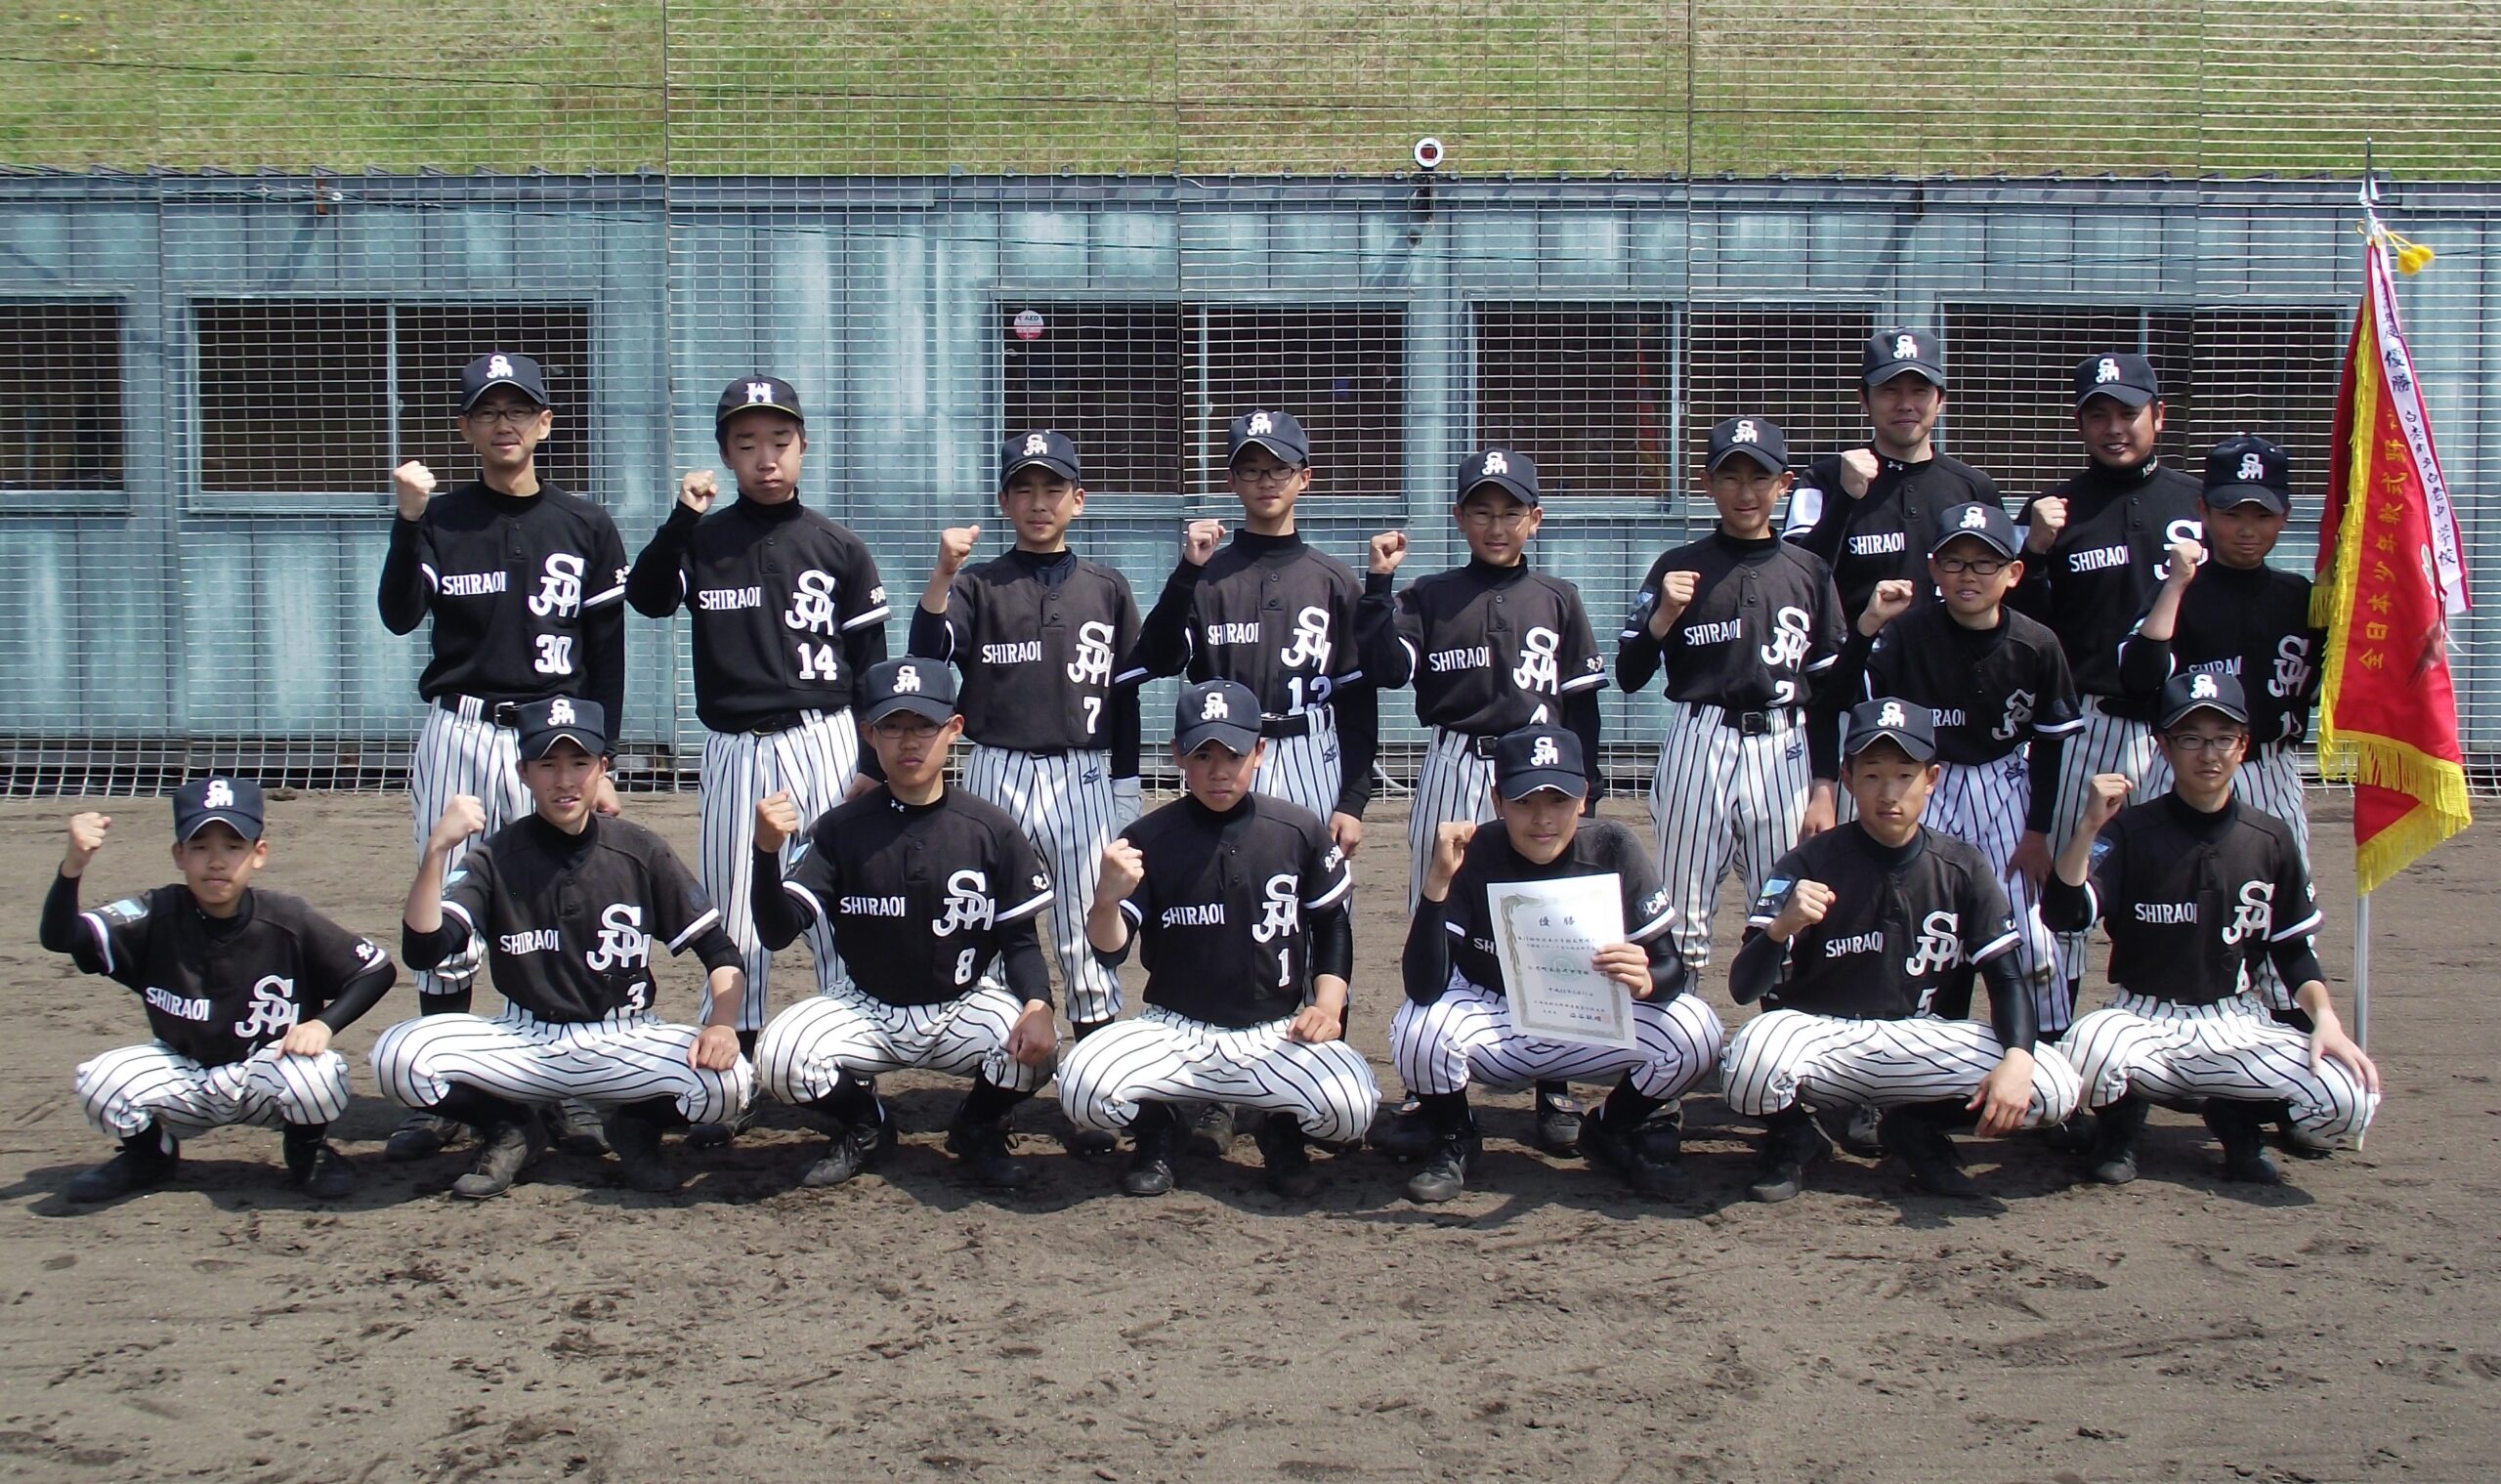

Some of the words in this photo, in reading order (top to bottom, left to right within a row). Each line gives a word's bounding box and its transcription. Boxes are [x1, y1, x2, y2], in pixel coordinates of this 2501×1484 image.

[1848, 531, 1905, 555] SHIRAOI
[2068, 545, 2130, 572] SHIRAOI
[441, 571, 507, 596] SHIRAOI
[698, 586, 762, 611] SHIRAOI
[1208, 621, 1260, 646] SHIRAOI
[1683, 617, 1742, 646] SHIRAOI
[534, 633, 572, 675] 30
[797, 642, 838, 681] 14
[982, 640, 1042, 664] SHIRAOI
[1428, 646, 1491, 672] SHIRAOI
[1082, 696, 1102, 735] 7
[1930, 707, 1966, 728] RAOI
[839, 896, 906, 917] SHIRAOI
[1162, 903, 1225, 928] SHIRAOI
[2134, 902, 2197, 924] SHIRAOI
[499, 928, 560, 955] SHIRAOI
[1825, 930, 1884, 957] SHIRAOI
[954, 948, 976, 986] 8
[1278, 948, 1291, 988] 1
[145, 987, 211, 1022] SHIRAOI
[626, 981, 648, 1009] 3
